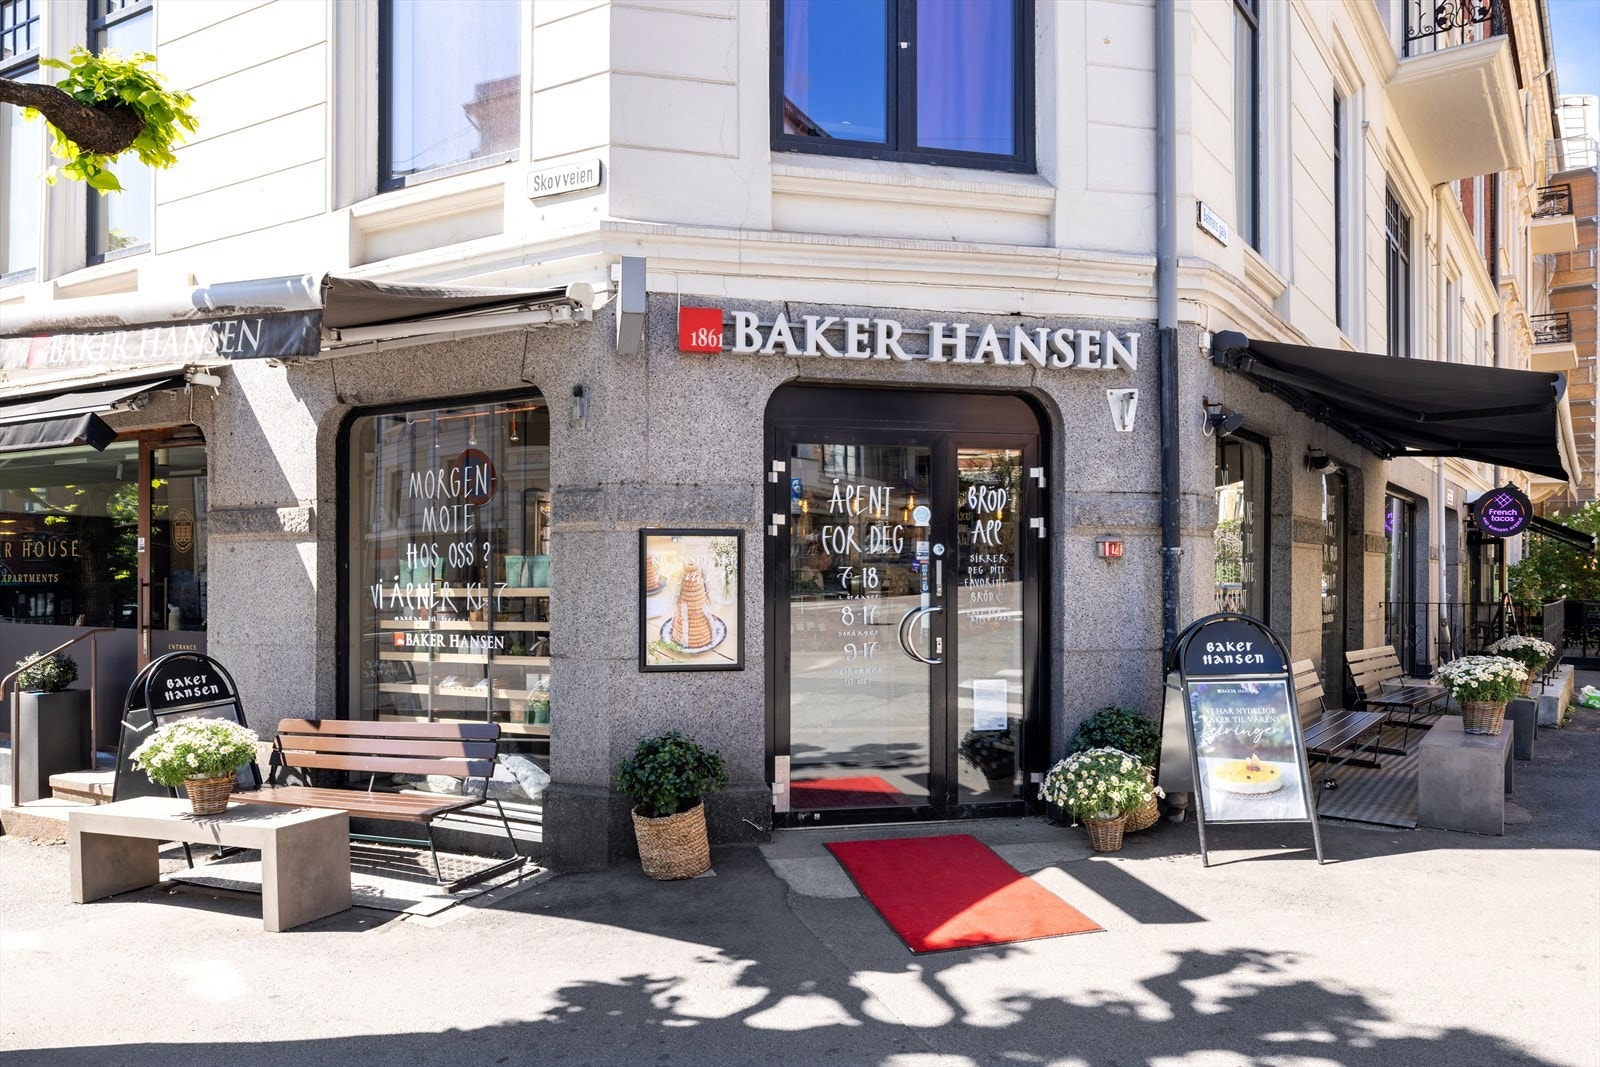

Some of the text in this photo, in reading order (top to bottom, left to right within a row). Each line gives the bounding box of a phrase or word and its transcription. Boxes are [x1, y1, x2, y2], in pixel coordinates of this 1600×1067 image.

[533, 166, 593, 192] Skovveien
[48, 318, 264, 363] BAKER HANSEN
[690, 311, 1141, 371] 1861 BAKER HANSEN
[409, 462, 497, 499] MORGEN-
[827, 478, 896, 517] ÅPENT
[422, 503, 475, 533] MØTE
[1488, 508, 1518, 516] French
[821, 525, 862, 555] FOR
[869, 524, 904, 555] DEG
[971, 519, 1003, 547] APP
[0, 539, 79, 558] R HOUSE
[406, 542, 444, 569] HOS
[449, 541, 474, 569] OSS
[969, 553, 1008, 563] SIKKER
[1, 573, 60, 583] APARTMENTS
[968, 564, 1005, 575] DEG DITT
[964, 577, 1008, 590] FAVORITT
[390, 575, 458, 613] ÅPNER
[494, 582, 508, 612] 7
[168, 643, 197, 651] ENTRANCE
[405, 633, 446, 647] BAKER
[449, 634, 505, 650] HANSEN
[1206, 641, 1253, 652] Baker
[1202, 653, 1264, 665] Hansen
[166, 674, 208, 689] Baker
[164, 684, 219, 701] Hansen
[1216, 707, 1235, 715] HAR
[1236, 707, 1276, 715] NYDELIGE
[1248, 714, 1281, 723] VÅRENS
